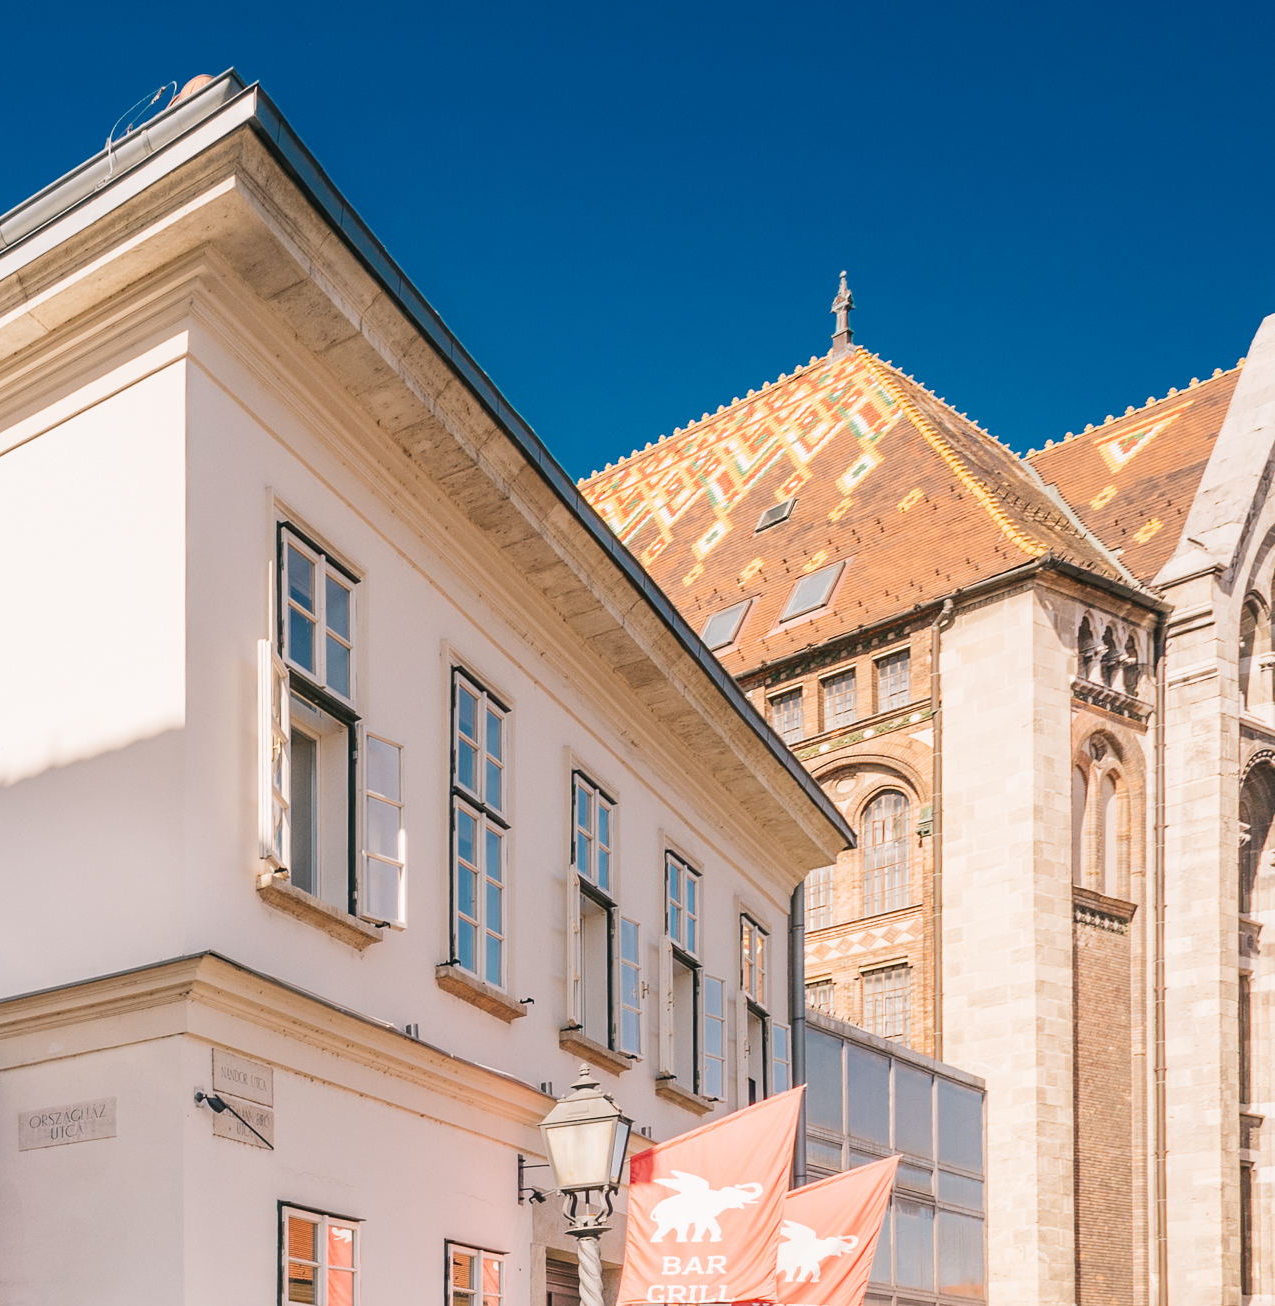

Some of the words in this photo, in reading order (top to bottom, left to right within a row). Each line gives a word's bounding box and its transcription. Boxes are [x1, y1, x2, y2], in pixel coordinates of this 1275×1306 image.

[250, 1075, 267, 1092] UTCA
[50, 1122, 83, 1140] UTCA
[661, 1255, 727, 1275] BAR
[646, 1285, 735, 1303] GRILL
